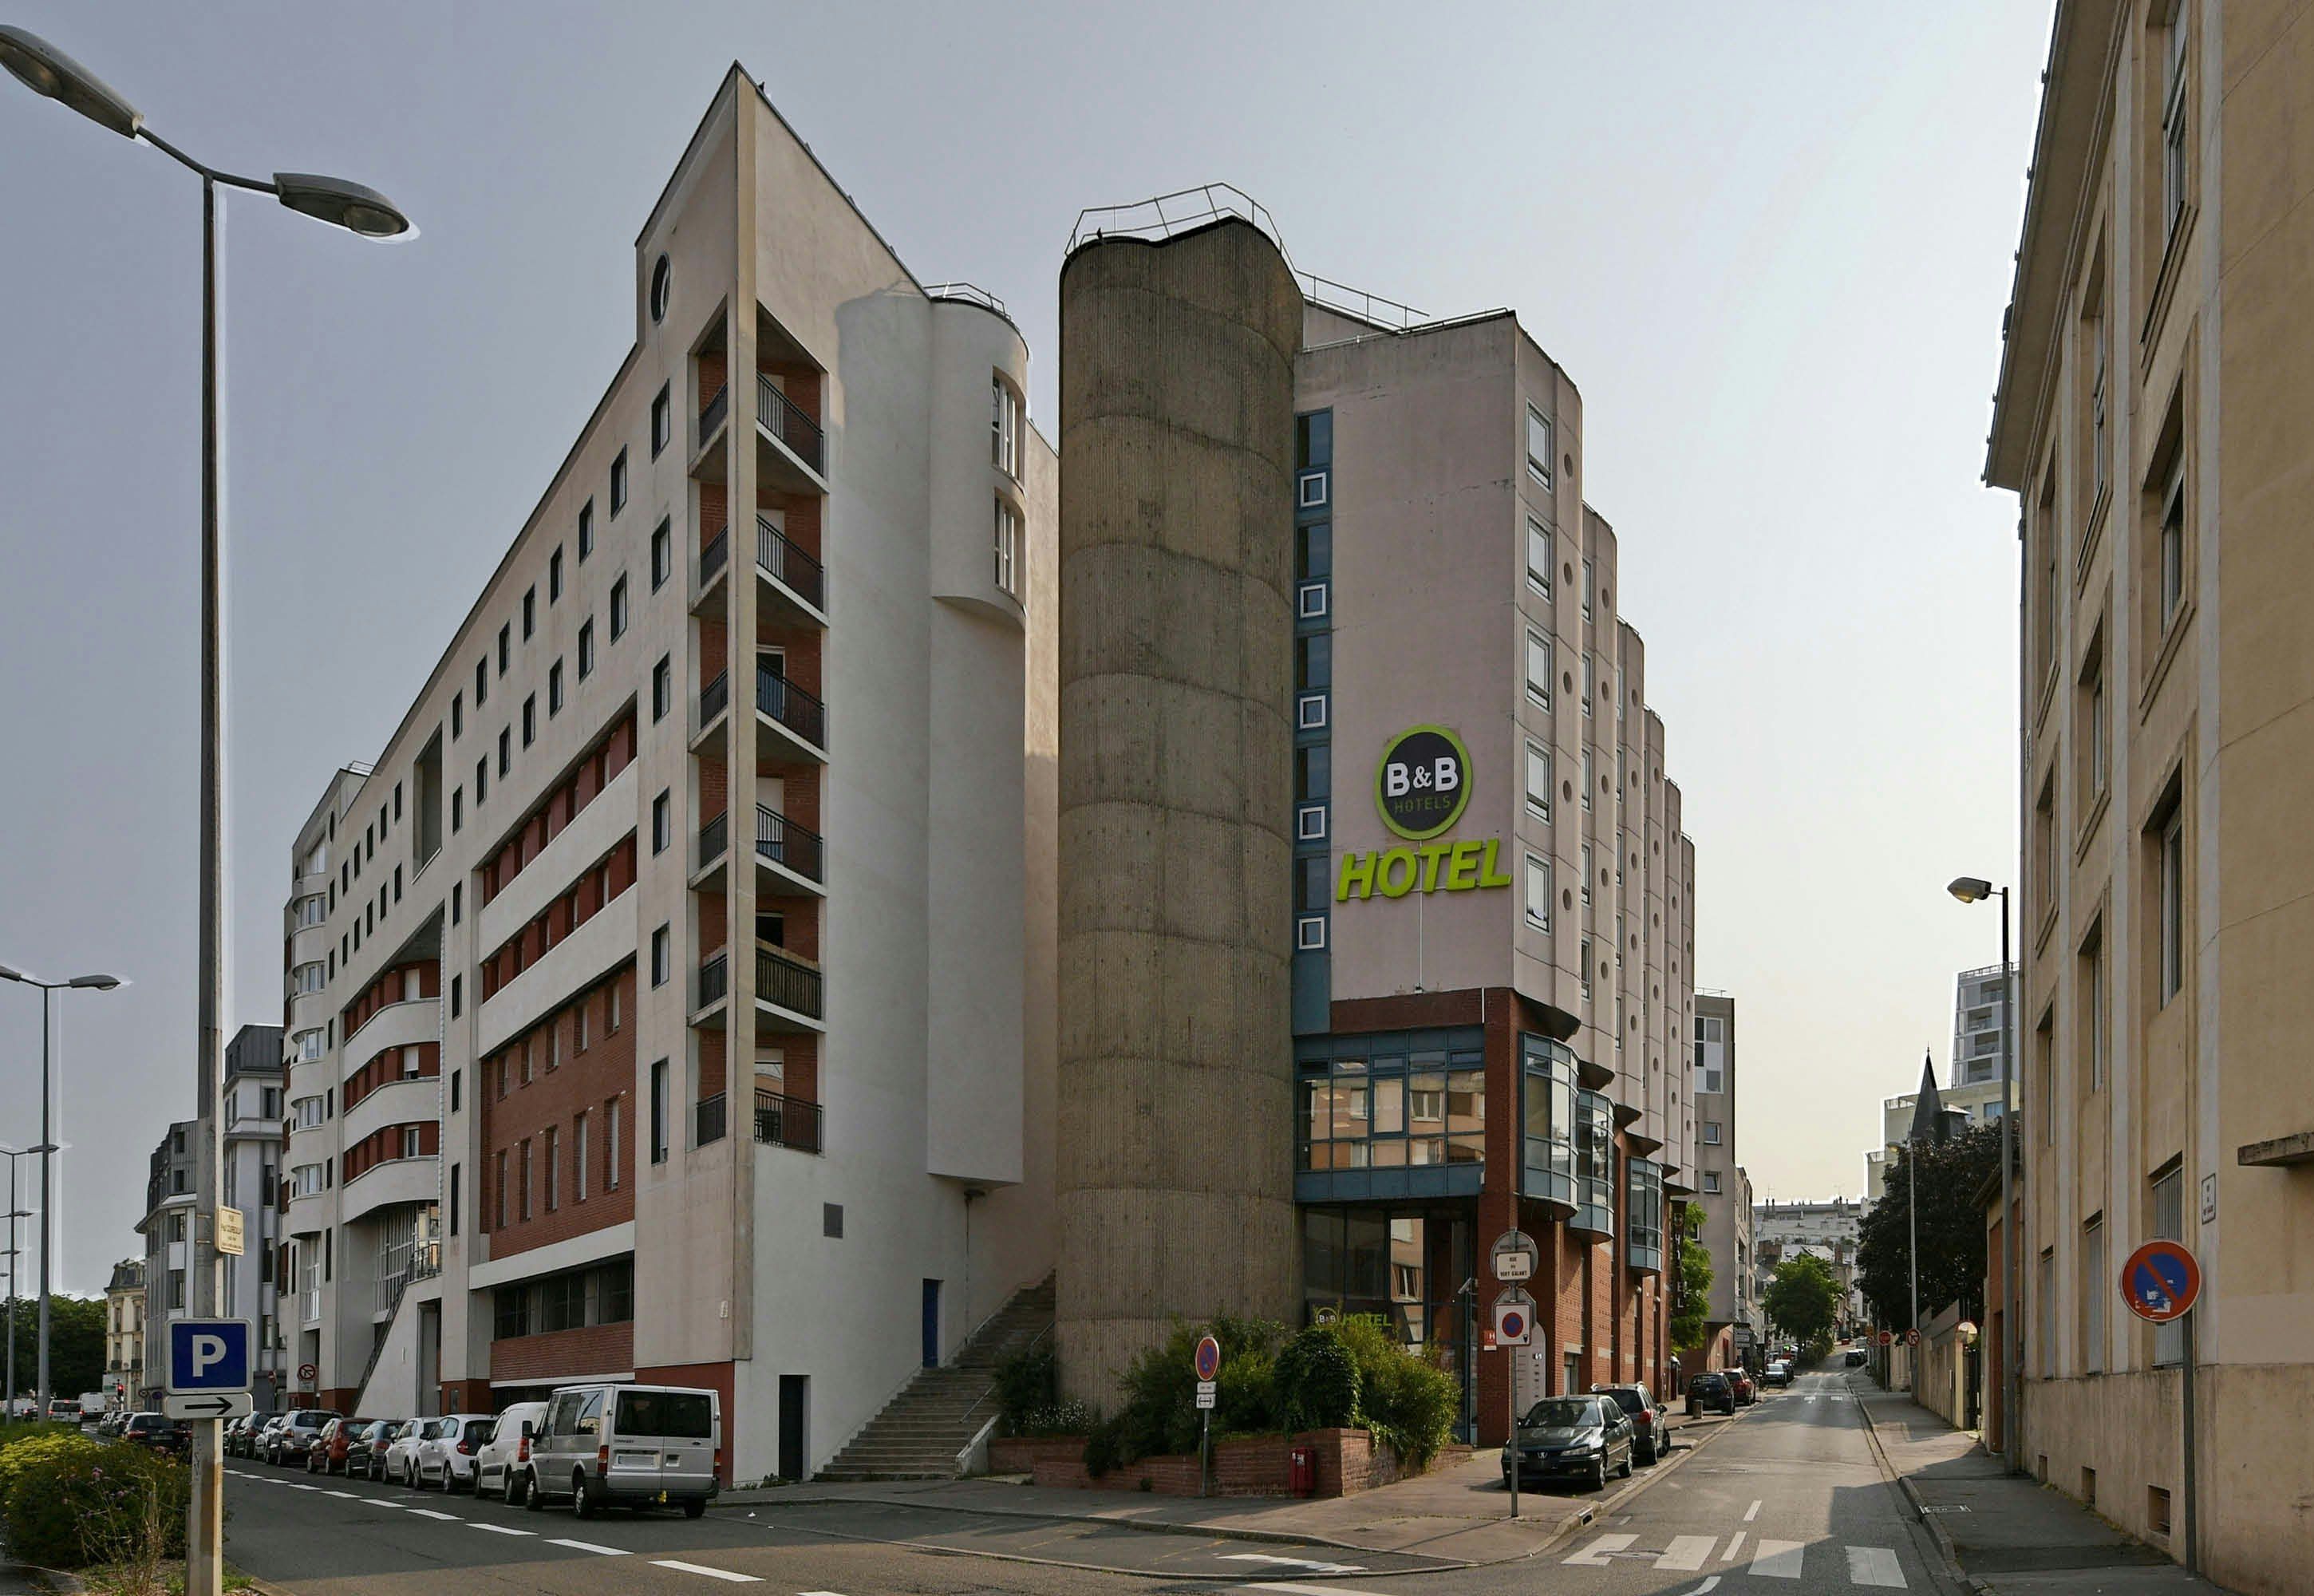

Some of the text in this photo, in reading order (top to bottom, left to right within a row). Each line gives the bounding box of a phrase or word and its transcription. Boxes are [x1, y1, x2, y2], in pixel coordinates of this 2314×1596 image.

[1387, 757, 1459, 797] B&B
[1394, 796, 1452, 813] HOTELS
[1336, 838, 1512, 902] HOTEL
[192, 1334, 227, 1377] P
